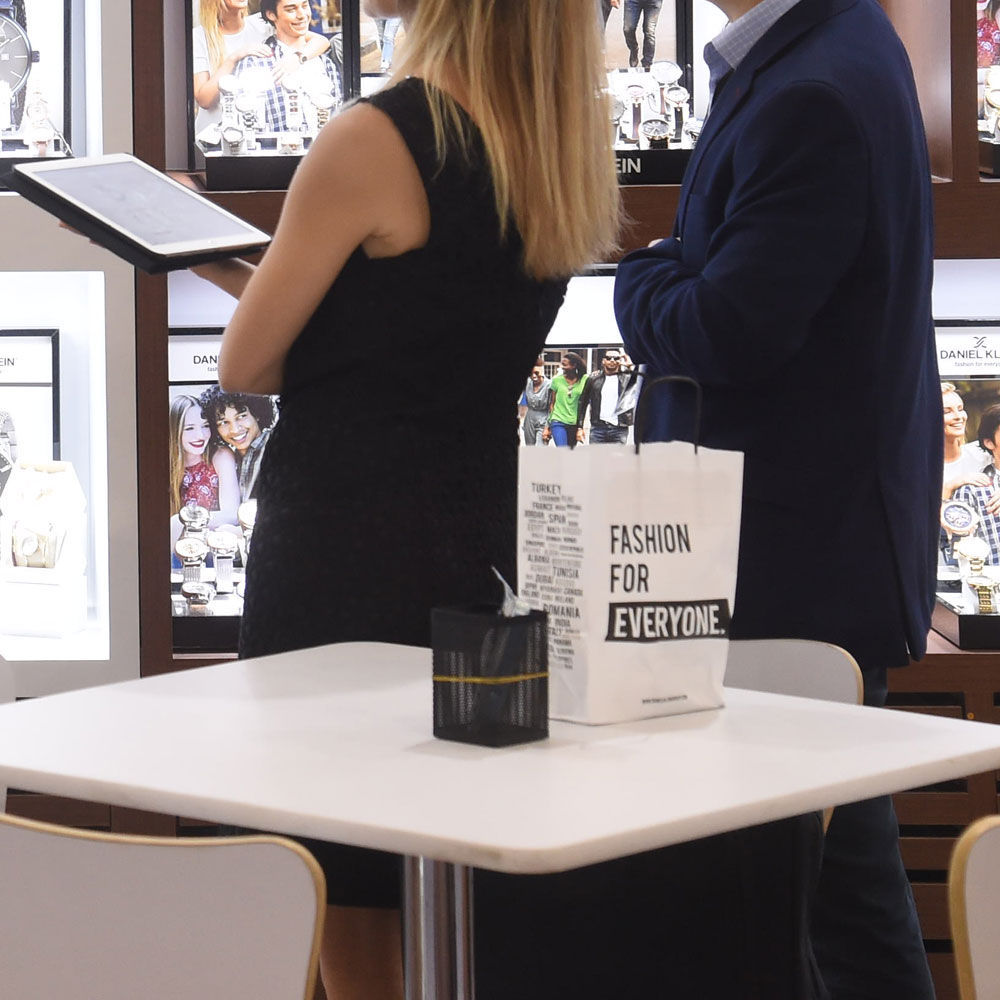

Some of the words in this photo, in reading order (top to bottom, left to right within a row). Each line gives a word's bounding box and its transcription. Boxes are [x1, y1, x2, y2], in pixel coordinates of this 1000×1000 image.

[193, 355, 218, 365] DAN
[940, 349, 982, 360] DANIEL
[531, 482, 562, 496] TURKEY
[610, 524, 692, 555] FASHION
[552, 566, 579, 579] TUNISIA
[610, 563, 649, 594] FOR
[614, 604, 726, 638] EVERYONE.
